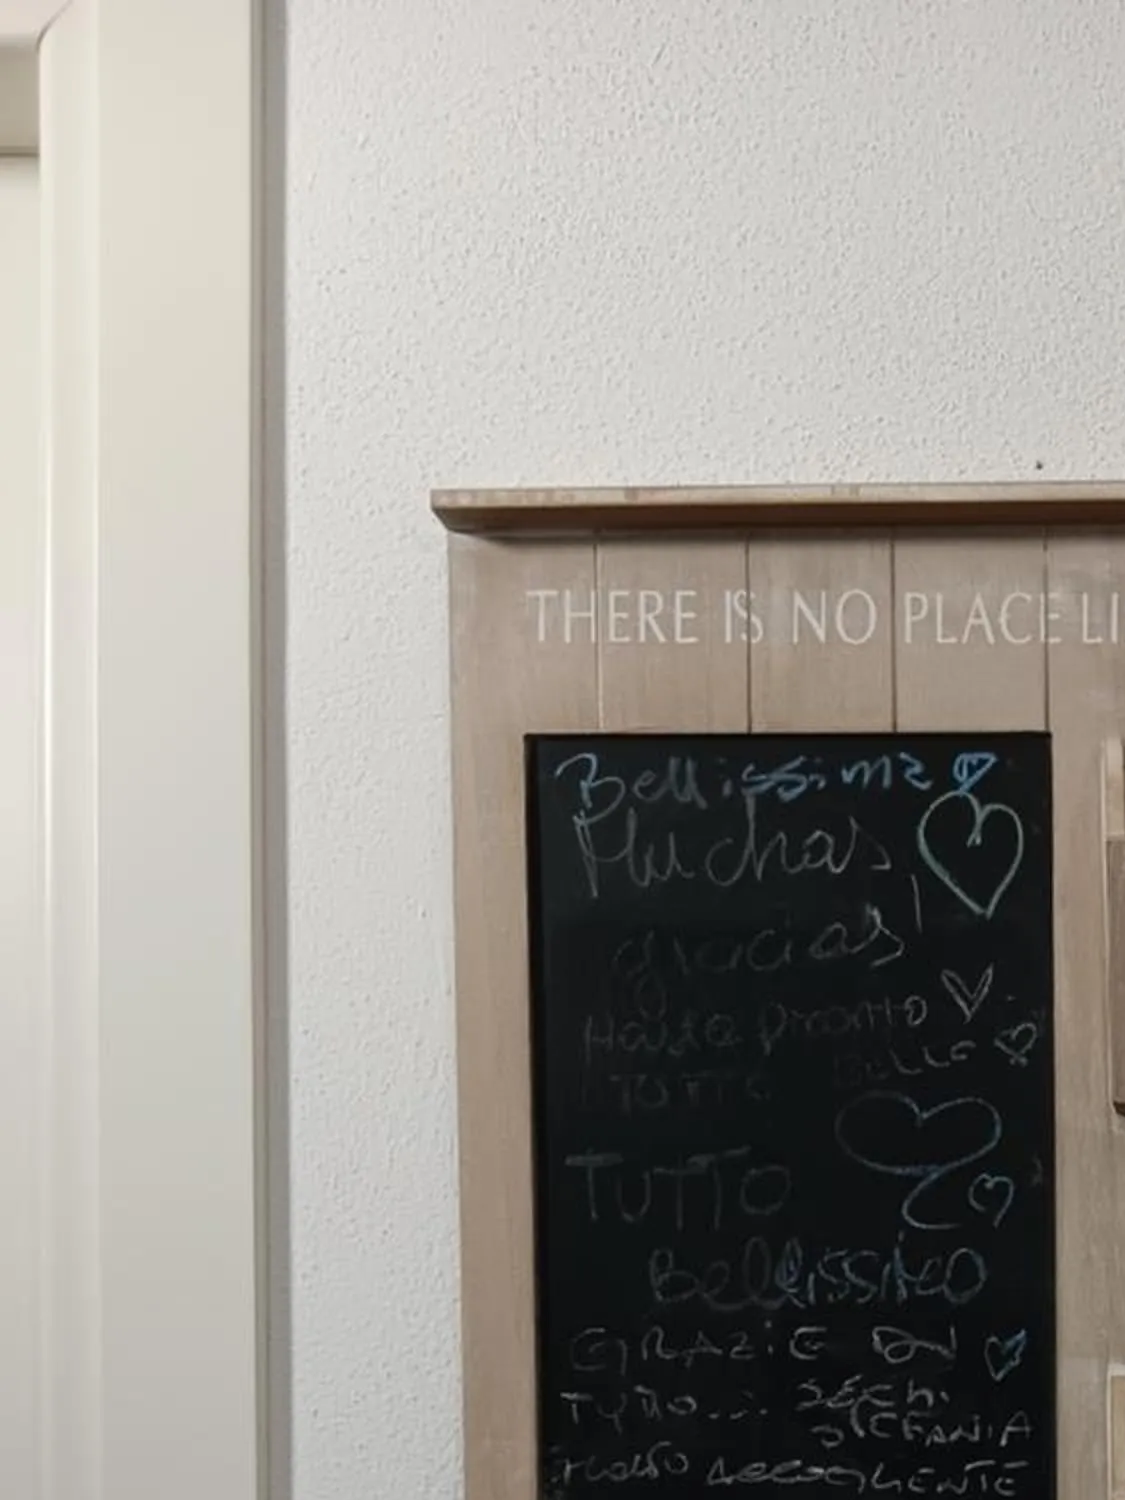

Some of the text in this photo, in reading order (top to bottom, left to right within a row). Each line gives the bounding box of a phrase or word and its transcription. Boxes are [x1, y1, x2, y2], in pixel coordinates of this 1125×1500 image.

[526, 588, 699, 645] THERE
[724, 588, 763, 645] IS
[791, 588, 878, 645] NO
[904, 591, 1063, 645] PLACE
